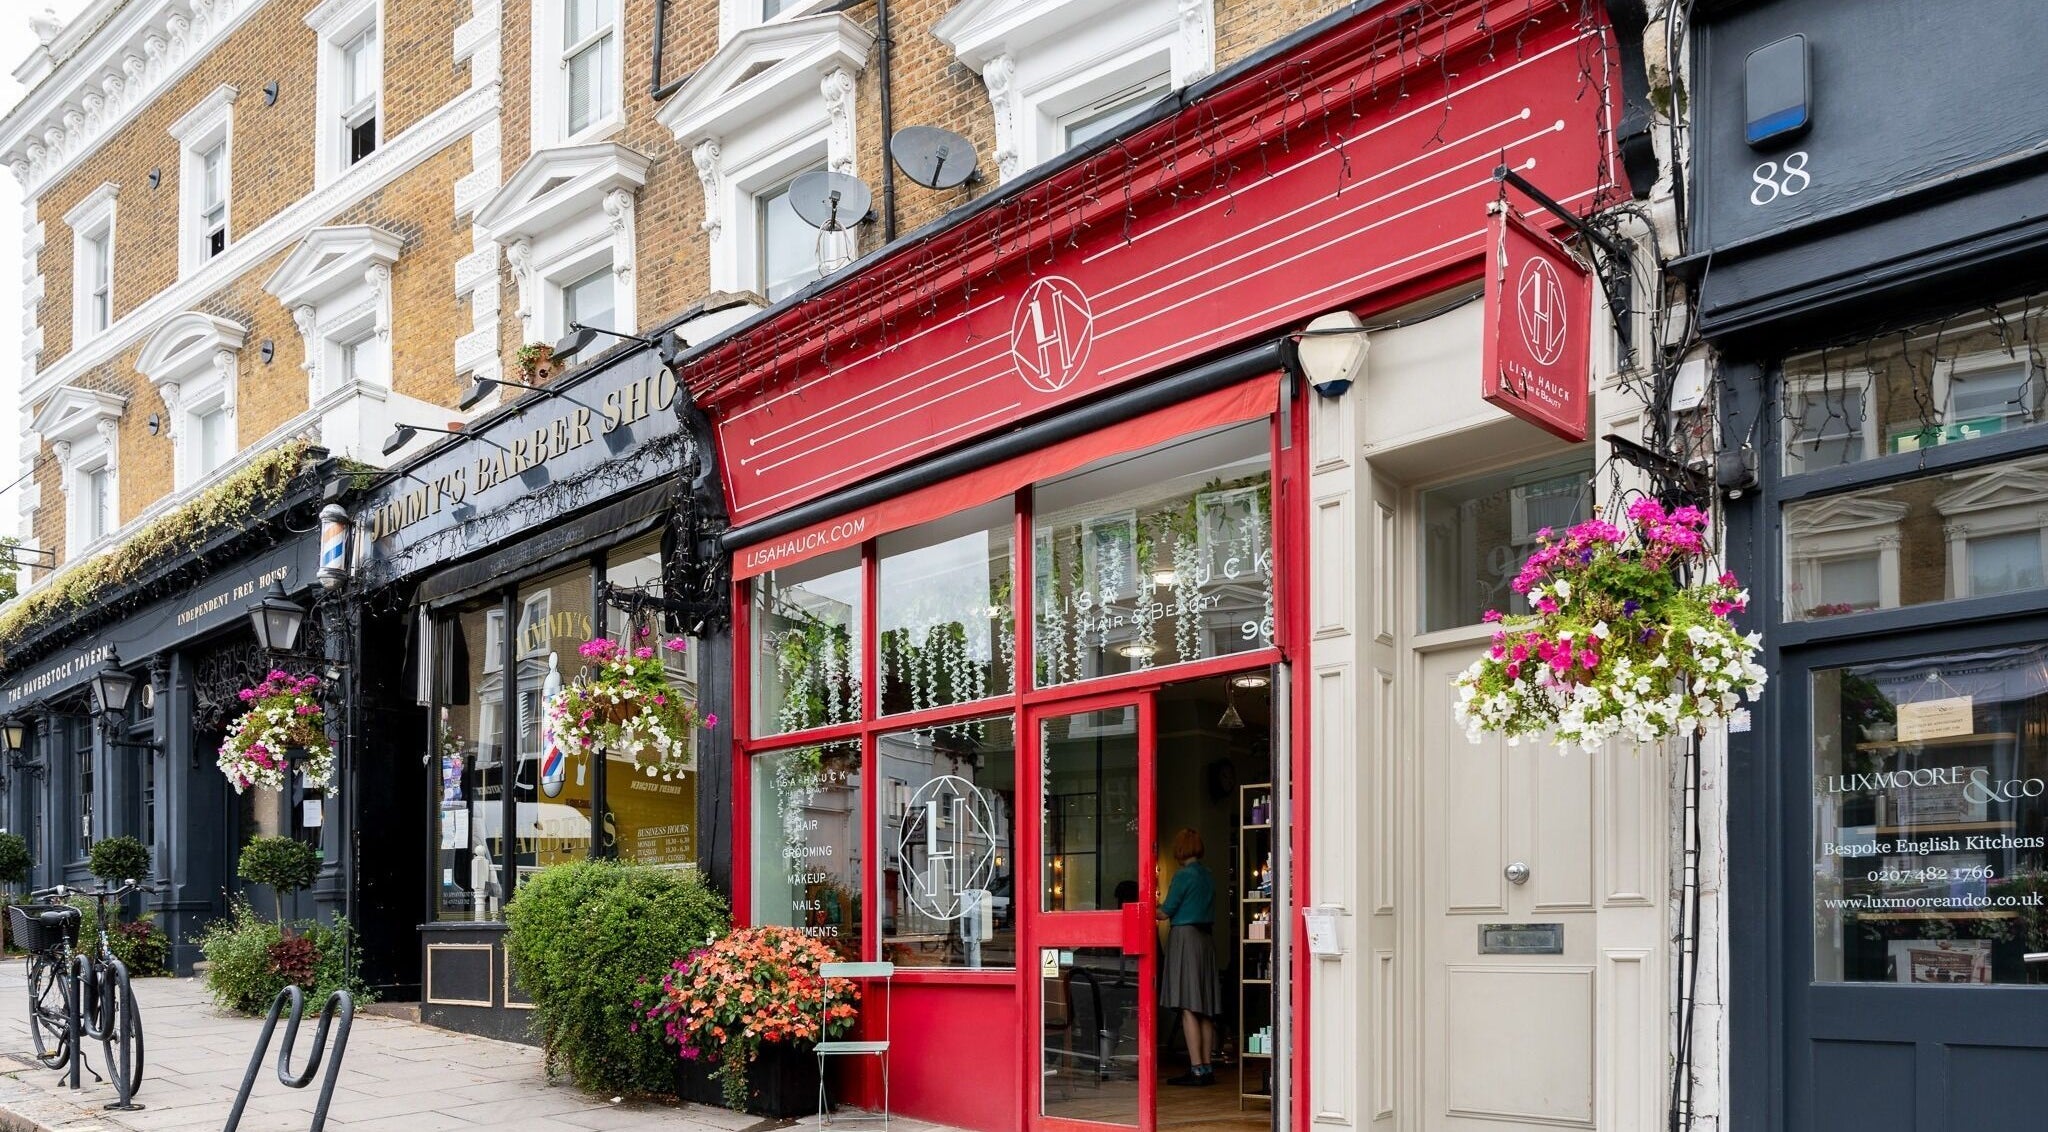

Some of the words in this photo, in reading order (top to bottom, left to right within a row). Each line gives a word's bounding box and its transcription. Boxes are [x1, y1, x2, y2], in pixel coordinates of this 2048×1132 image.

[1750, 151, 1811, 206] 88
[1509, 360, 1533, 381] LISA
[1538, 375, 1570, 401] HAUCK
[1518, 378, 1535, 393] HIR
[370, 465, 466, 542] JIMMY'S
[473, 406, 594, 496] BARBER
[747, 517, 865, 568] LISAHAUCK.COM
[177, 592, 229, 626] INDEPENDENT
[233, 580, 254, 601] FREE
[259, 565, 288, 589] HOUSE
[1044, 586, 1116, 620] LISA
[1143, 550, 1269, 598] HAUCK
[1084, 615, 1123, 632] HAIR
[1131, 608, 1146, 624] &
[516, 611, 592, 662] JIMMY'S
[8, 687, 21, 704] THE
[24, 661, 72, 697] HAVERSTOCK
[75, 645, 108, 672] TAVERN
[769, 777, 796, 789] LISA
[803, 770, 846, 785] HAUCK
[637, 826, 667, 838] BUSINESS
[667, 823, 690, 835] HOURS
[795, 820, 818, 831] HAIR
[782, 845, 833, 859] GROOMING
[1824, 840, 1891, 858] Bespoke
[1895, 837, 1960, 856] English
[1965, 833, 2045, 850] Kitchens
[787, 873, 827, 884] MAKEUP
[1867, 868, 1910, 882] 0207
[1914, 866, 1948, 882] 482
[1953, 864, 1995, 881] 1766
[792, 900, 821, 911] NAILS
[1824, 891, 2045, 909] www.luxmooreandco.co.uk
[782, 926, 838, 938] TMENTS
